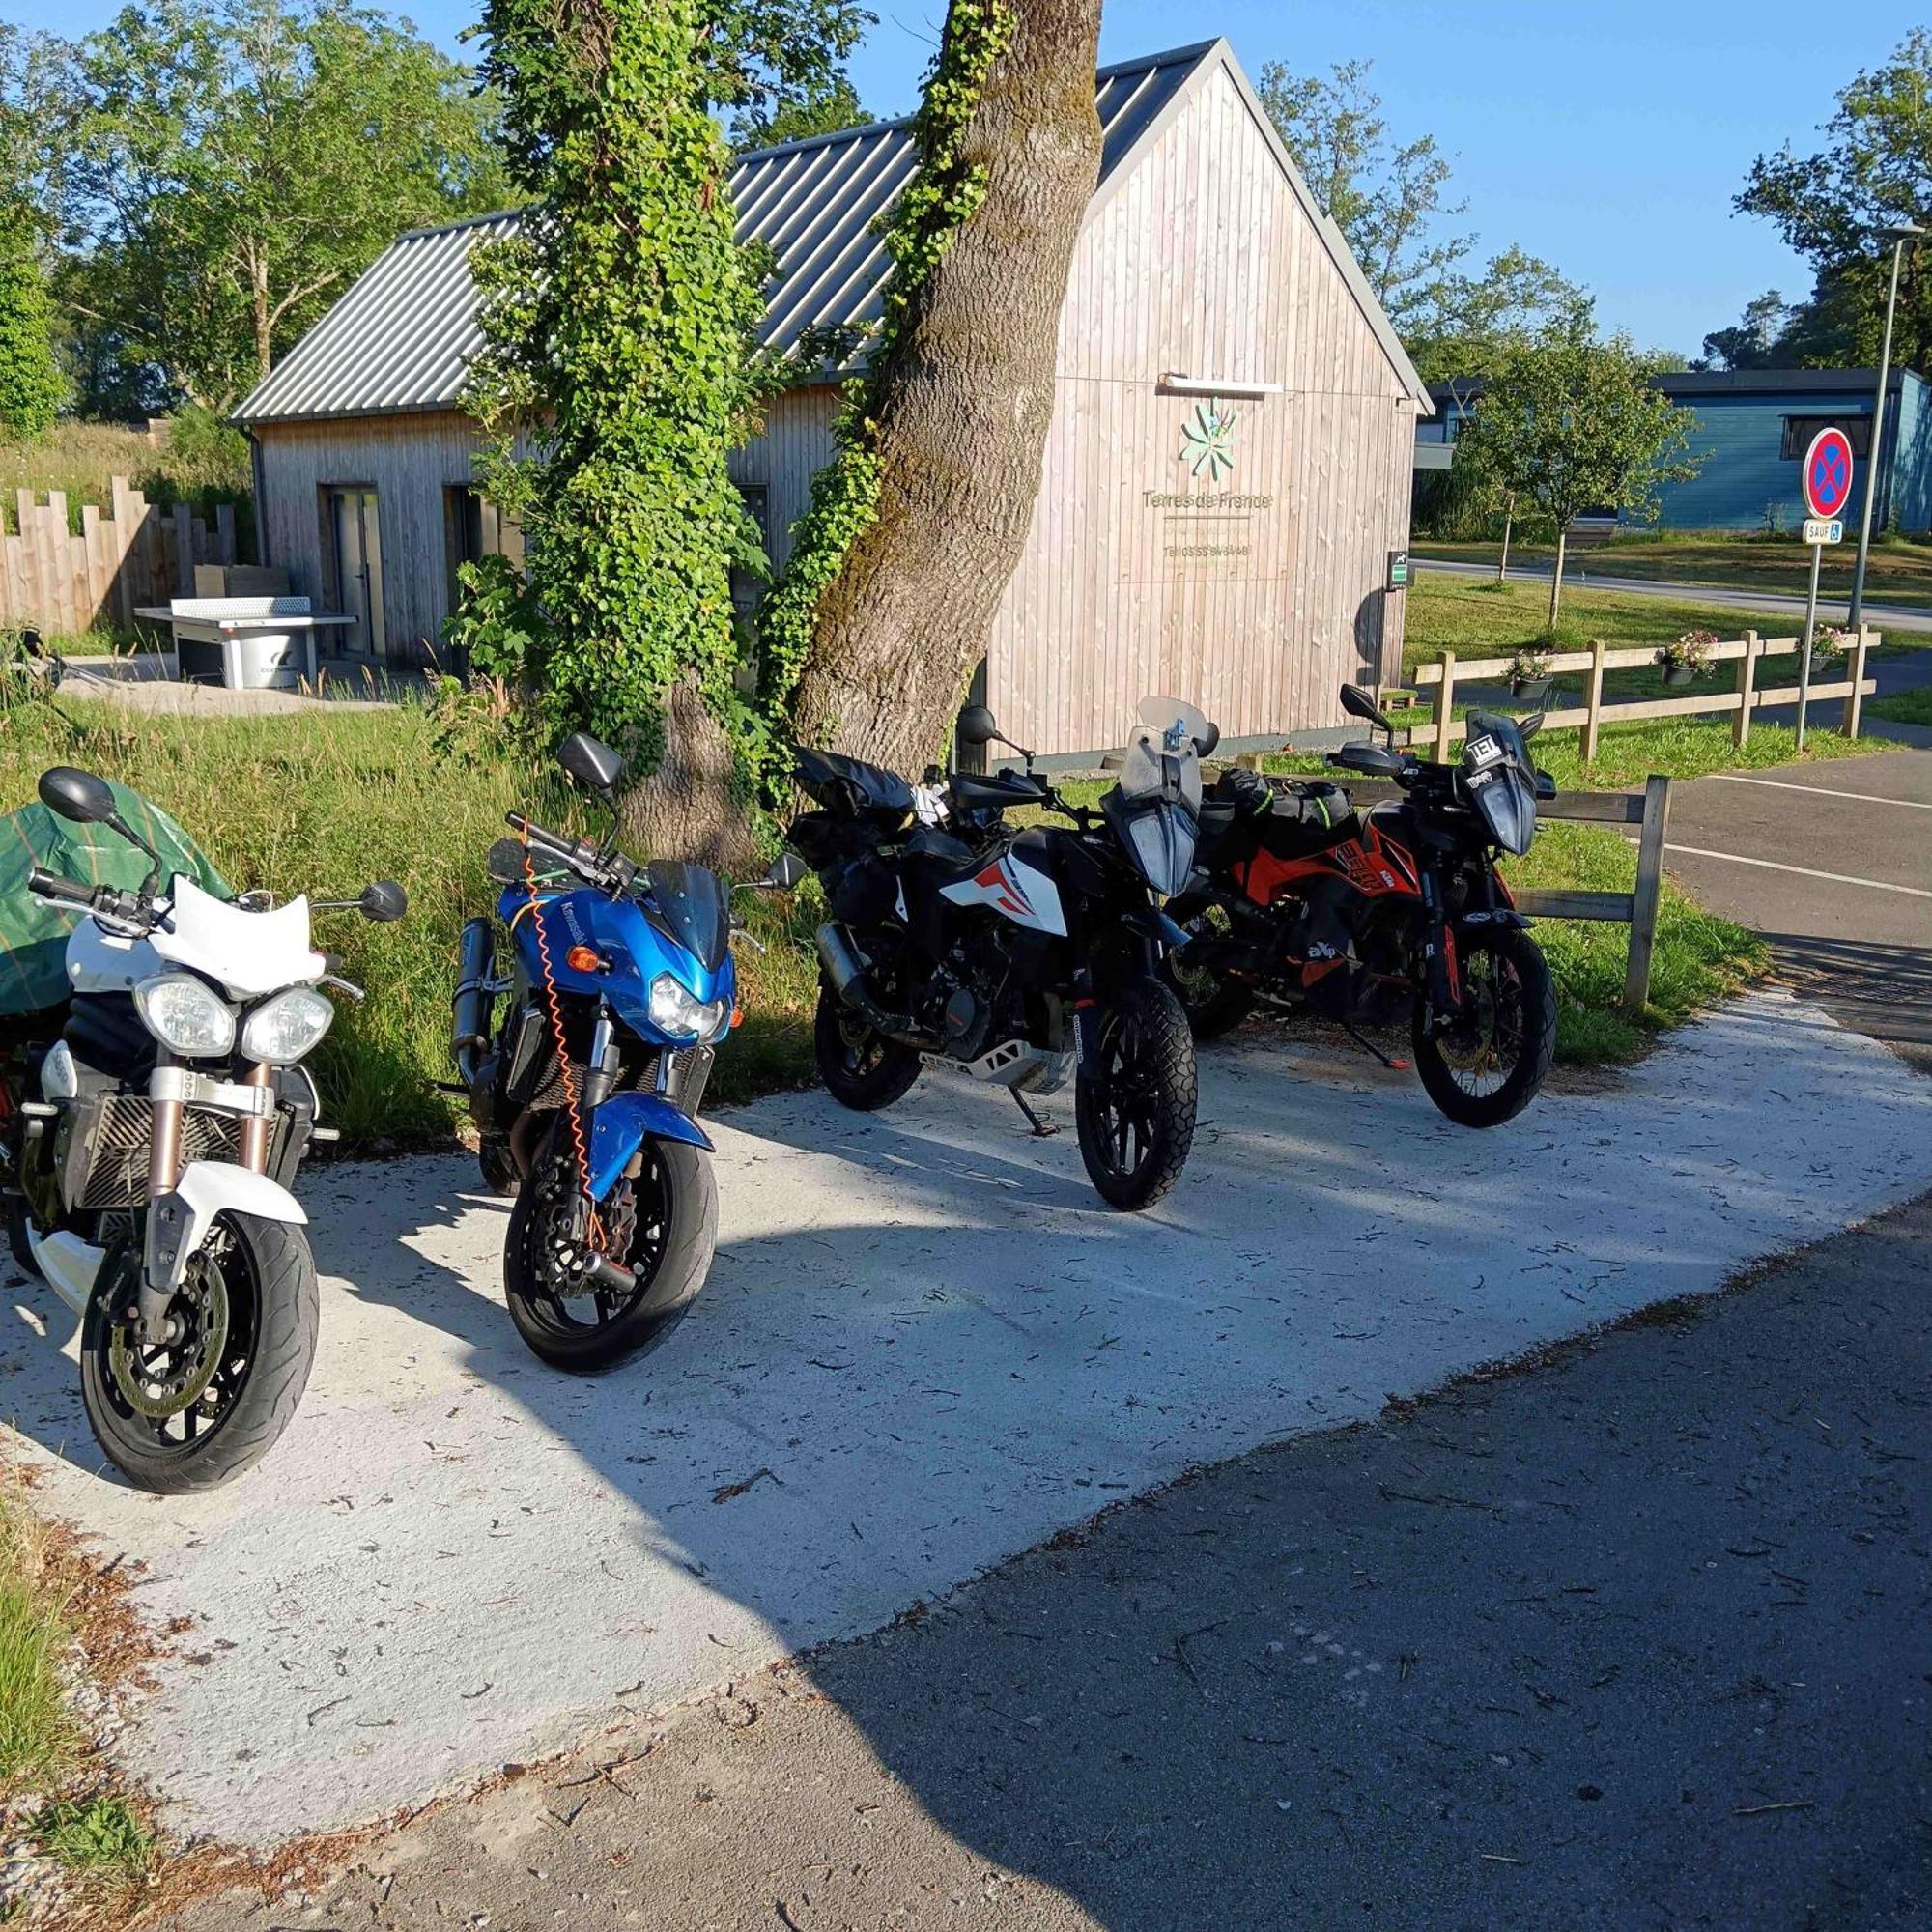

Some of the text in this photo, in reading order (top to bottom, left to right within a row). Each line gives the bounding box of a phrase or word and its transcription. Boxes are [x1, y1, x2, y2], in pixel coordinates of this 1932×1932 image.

[1142, 490, 1273, 509] Terres de France
[1809, 526, 1829, 538] SAUF
[560, 901, 588, 945] Kawasaki
